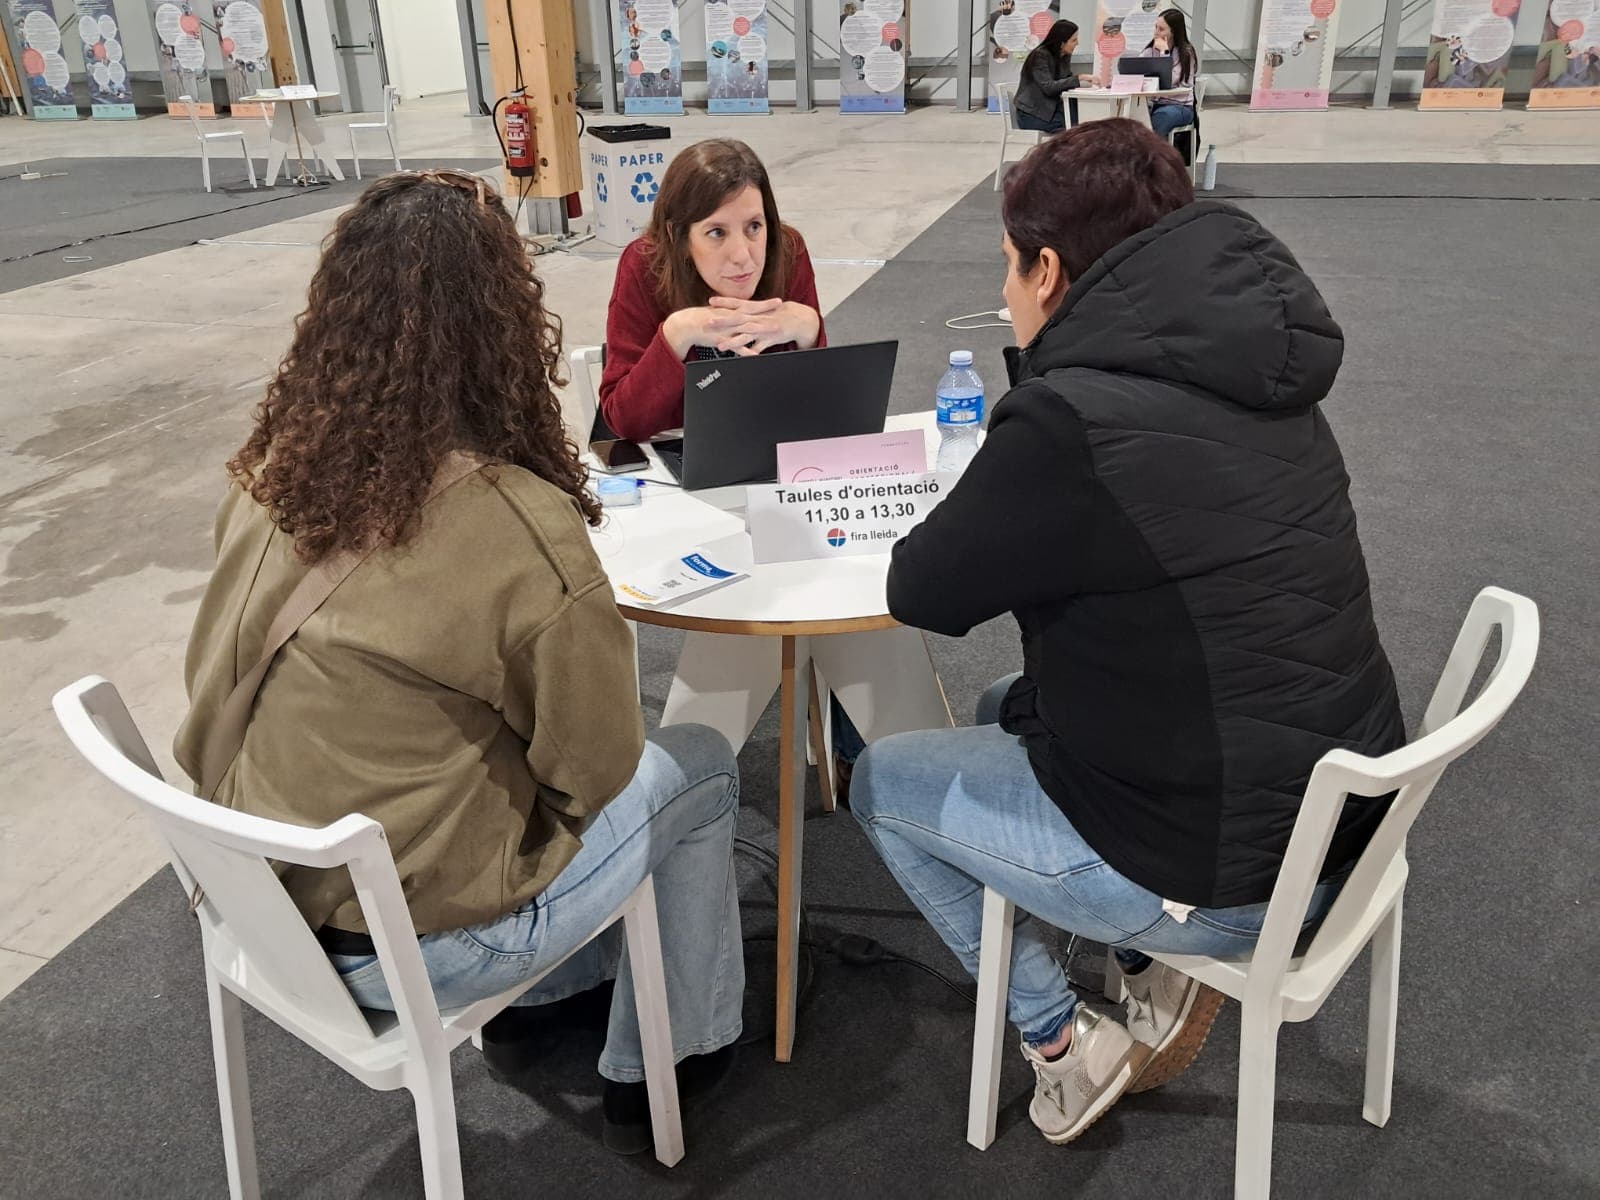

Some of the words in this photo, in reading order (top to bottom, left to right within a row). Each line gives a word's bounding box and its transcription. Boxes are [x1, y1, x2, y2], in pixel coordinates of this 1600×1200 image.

[591, 153, 608, 167] PAPER
[620, 152, 664, 167] PAPER
[849, 464, 899, 475] ORIENTACIÓ
[775, 487, 833, 504] Taules
[838, 479, 940, 501] d'orientació
[805, 507, 850, 525] 11,30
[855, 509, 865, 520] a
[870, 502, 915, 520] 13,30
[850, 531, 868, 541] fira
[870, 529, 898, 540] lleida
